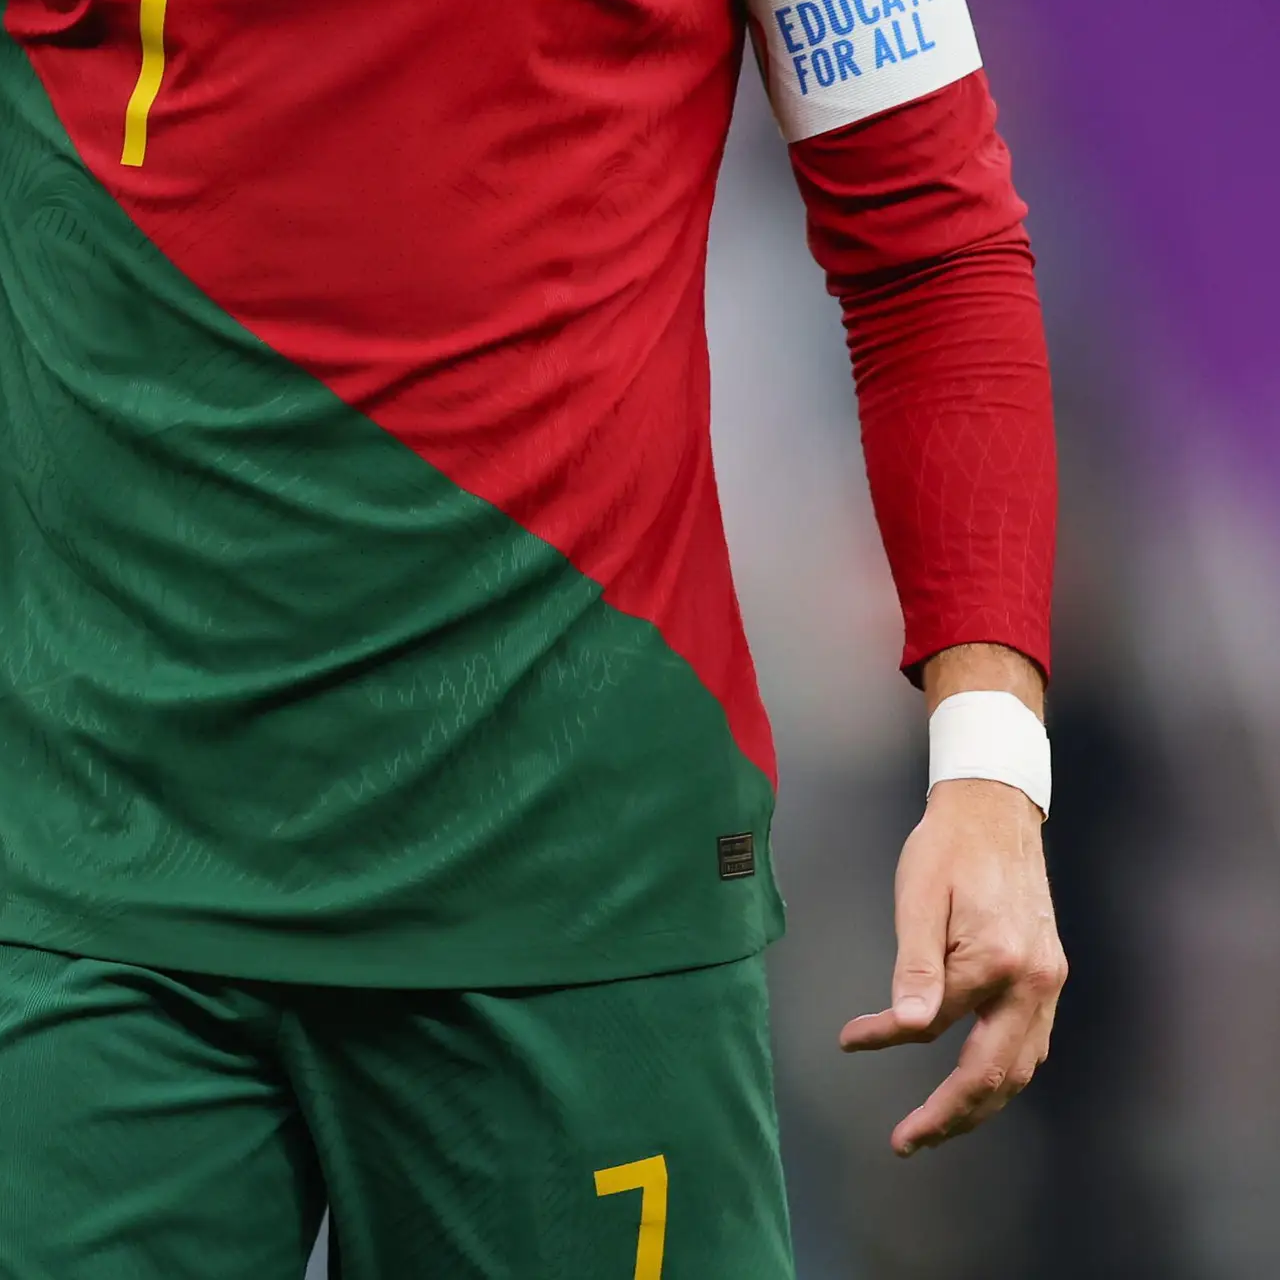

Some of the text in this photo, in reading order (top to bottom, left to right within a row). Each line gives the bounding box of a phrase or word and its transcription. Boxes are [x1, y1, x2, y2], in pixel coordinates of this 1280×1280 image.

[791, 11, 936, 96] FOR ALL
[594, 1153, 668, 1280] 7
